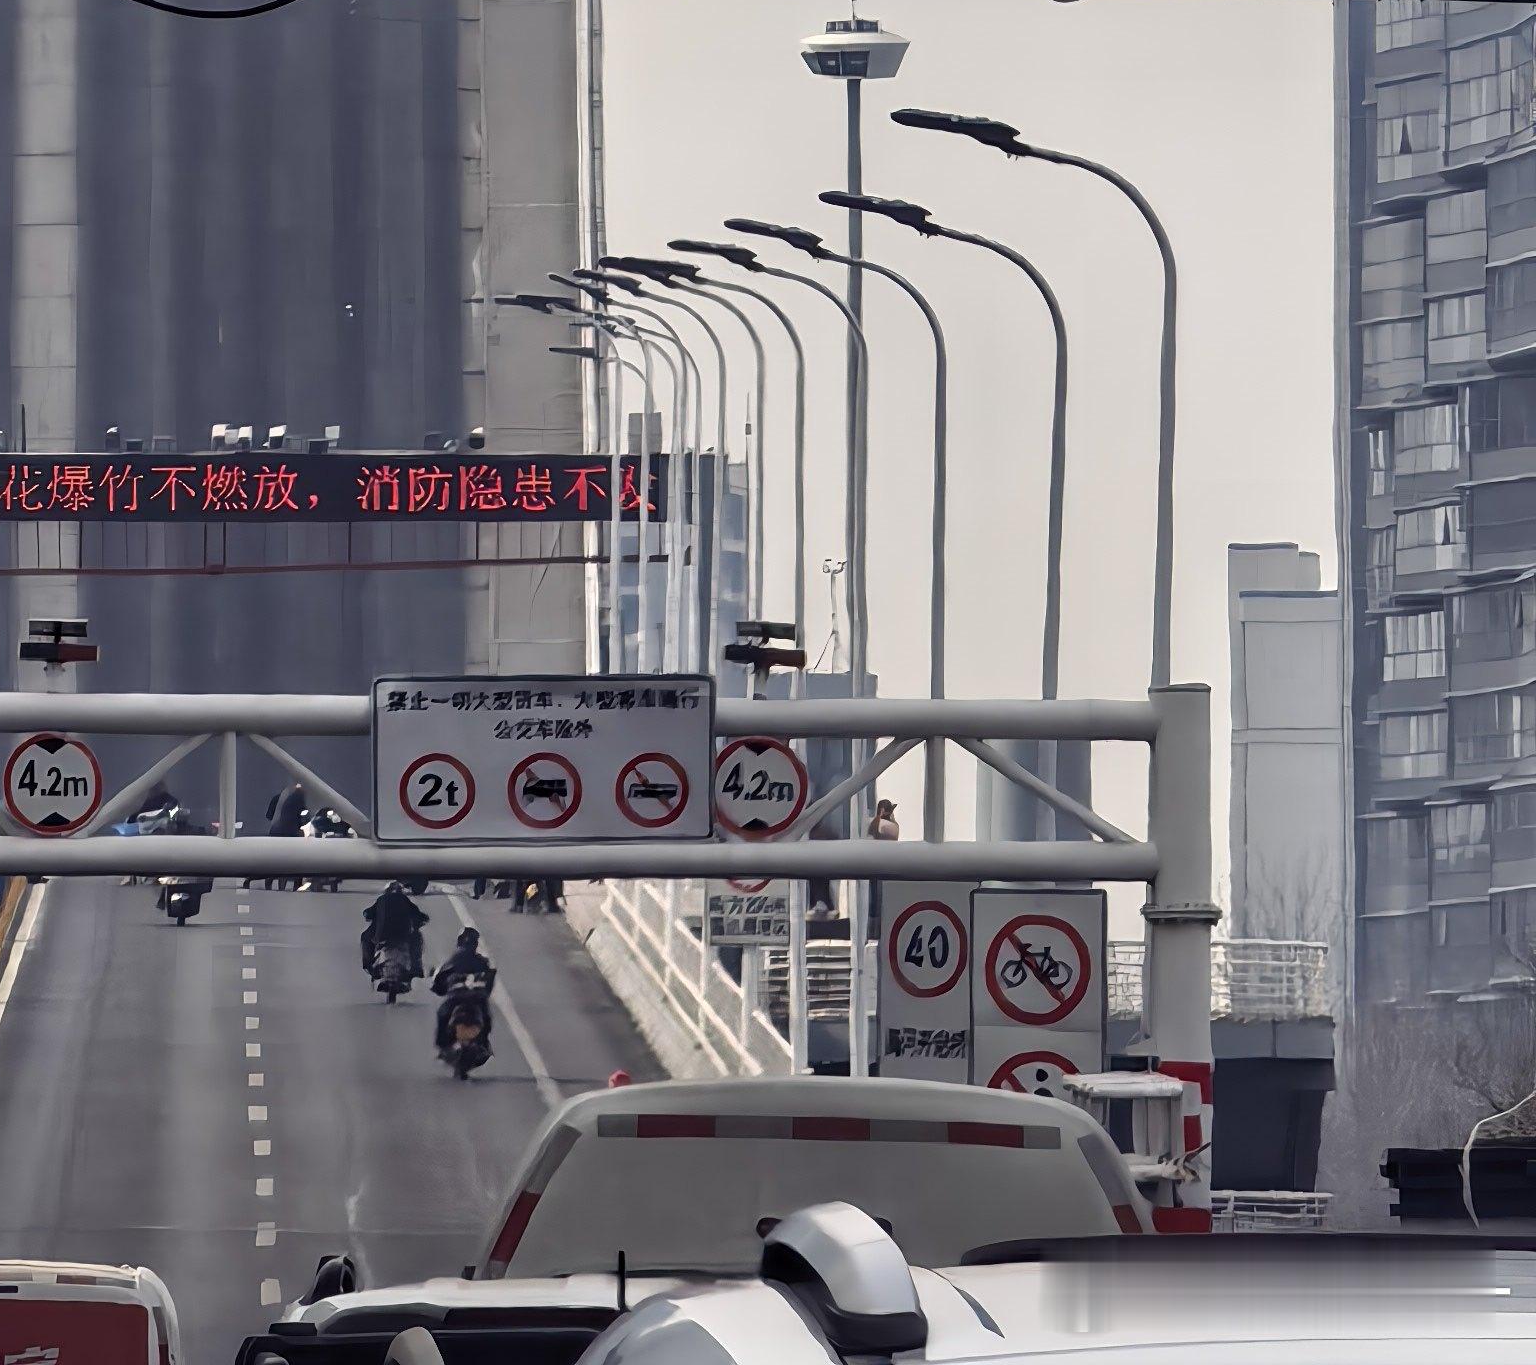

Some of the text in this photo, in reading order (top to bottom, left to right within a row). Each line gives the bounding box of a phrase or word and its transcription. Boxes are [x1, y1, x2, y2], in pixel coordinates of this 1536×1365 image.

[18, 759, 88, 796] 4.2m
[418, 773, 458, 807] 2t
[721, 763, 794, 802] 4.2m
[904, 924, 949, 968] 40
